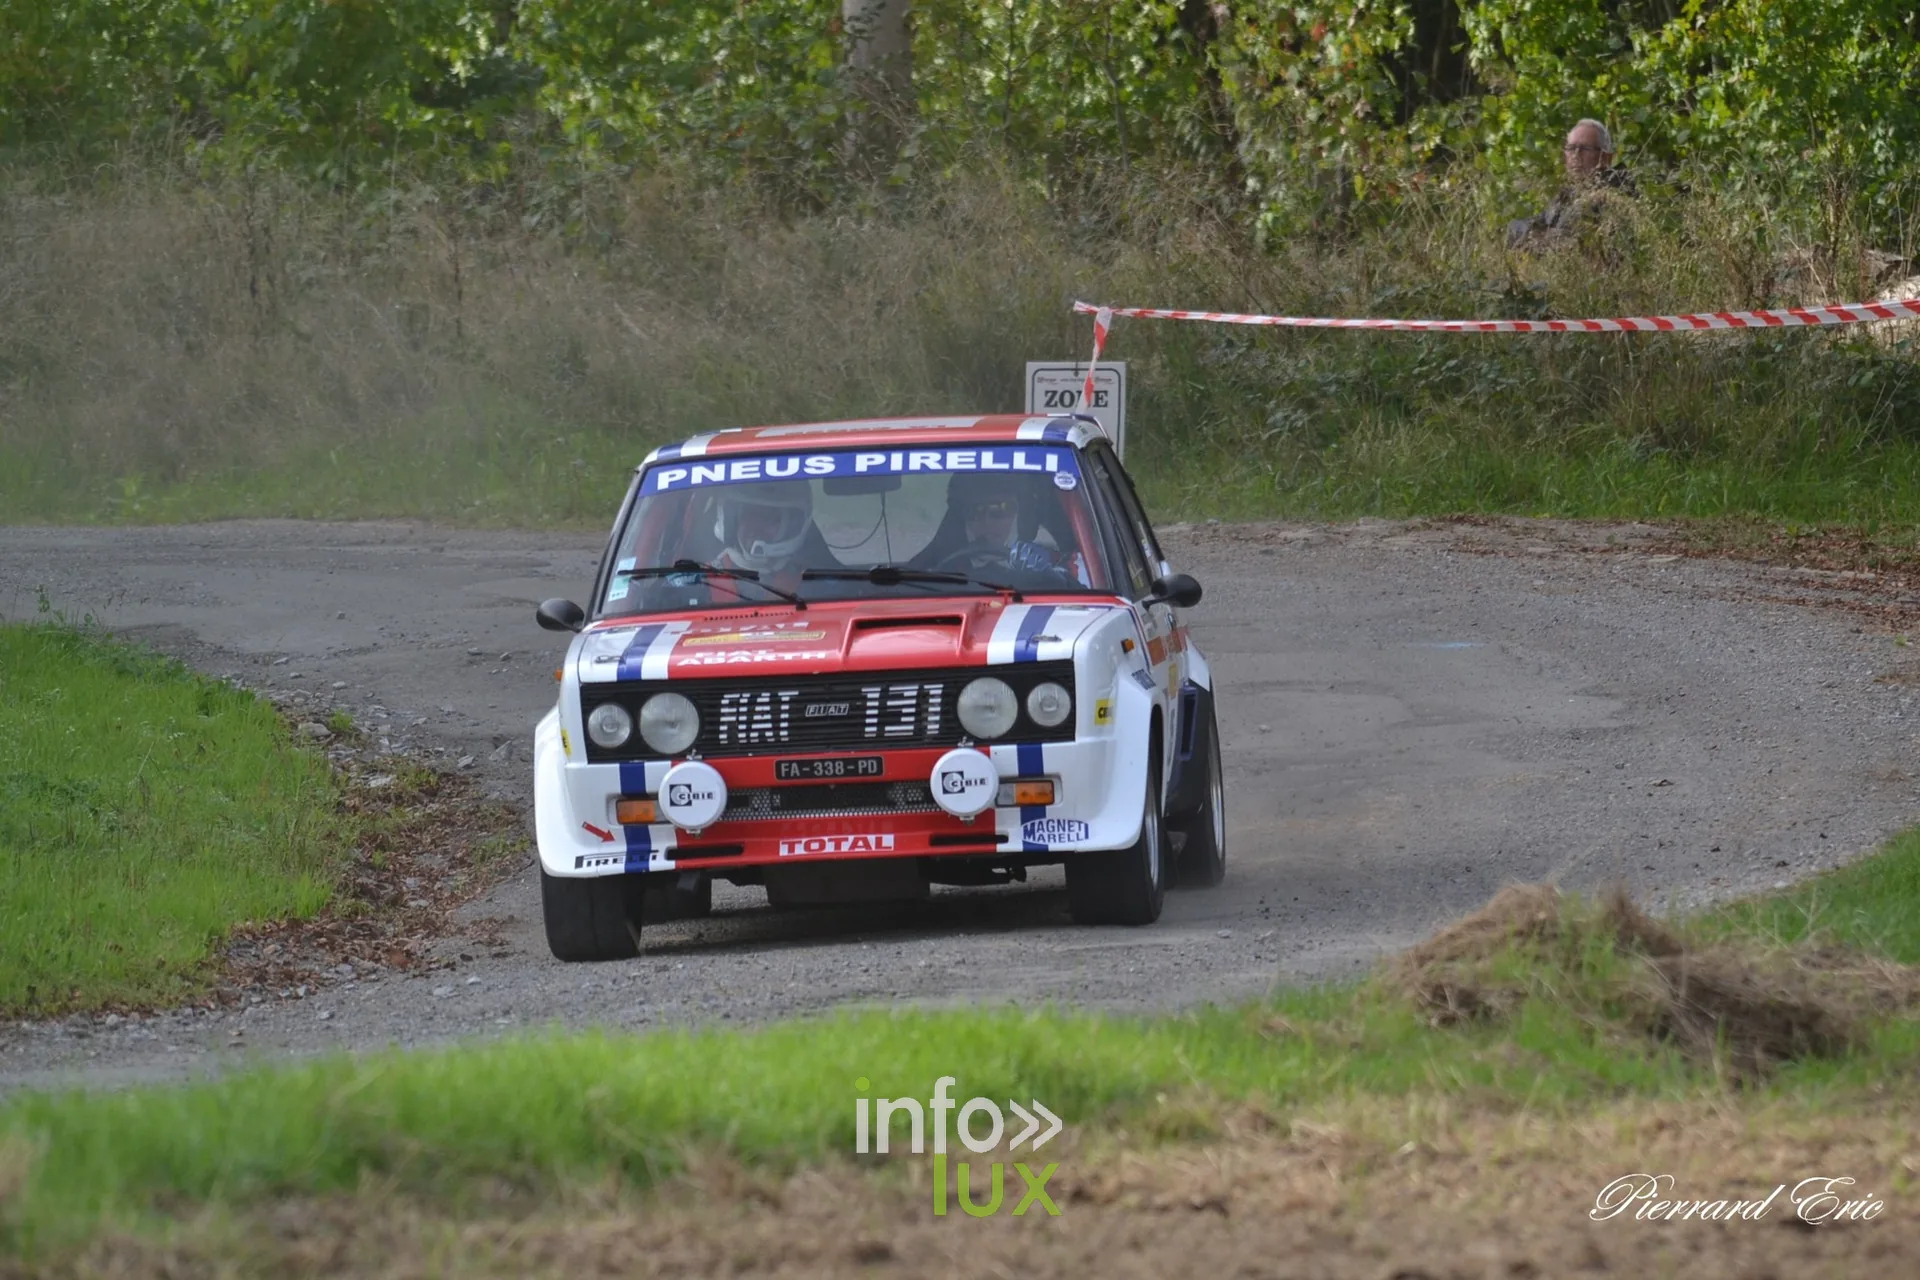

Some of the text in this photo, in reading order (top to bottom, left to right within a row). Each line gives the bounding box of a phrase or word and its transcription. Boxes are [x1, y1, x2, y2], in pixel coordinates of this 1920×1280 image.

[657, 451, 1058, 490] PNEUS PIRELLI
[719, 684, 944, 744] FIAT 131
[805, 703, 849, 717] FIAT
[780, 759, 878, 777] FA-338-PD
[781, 834, 893, 854] TOTAL
